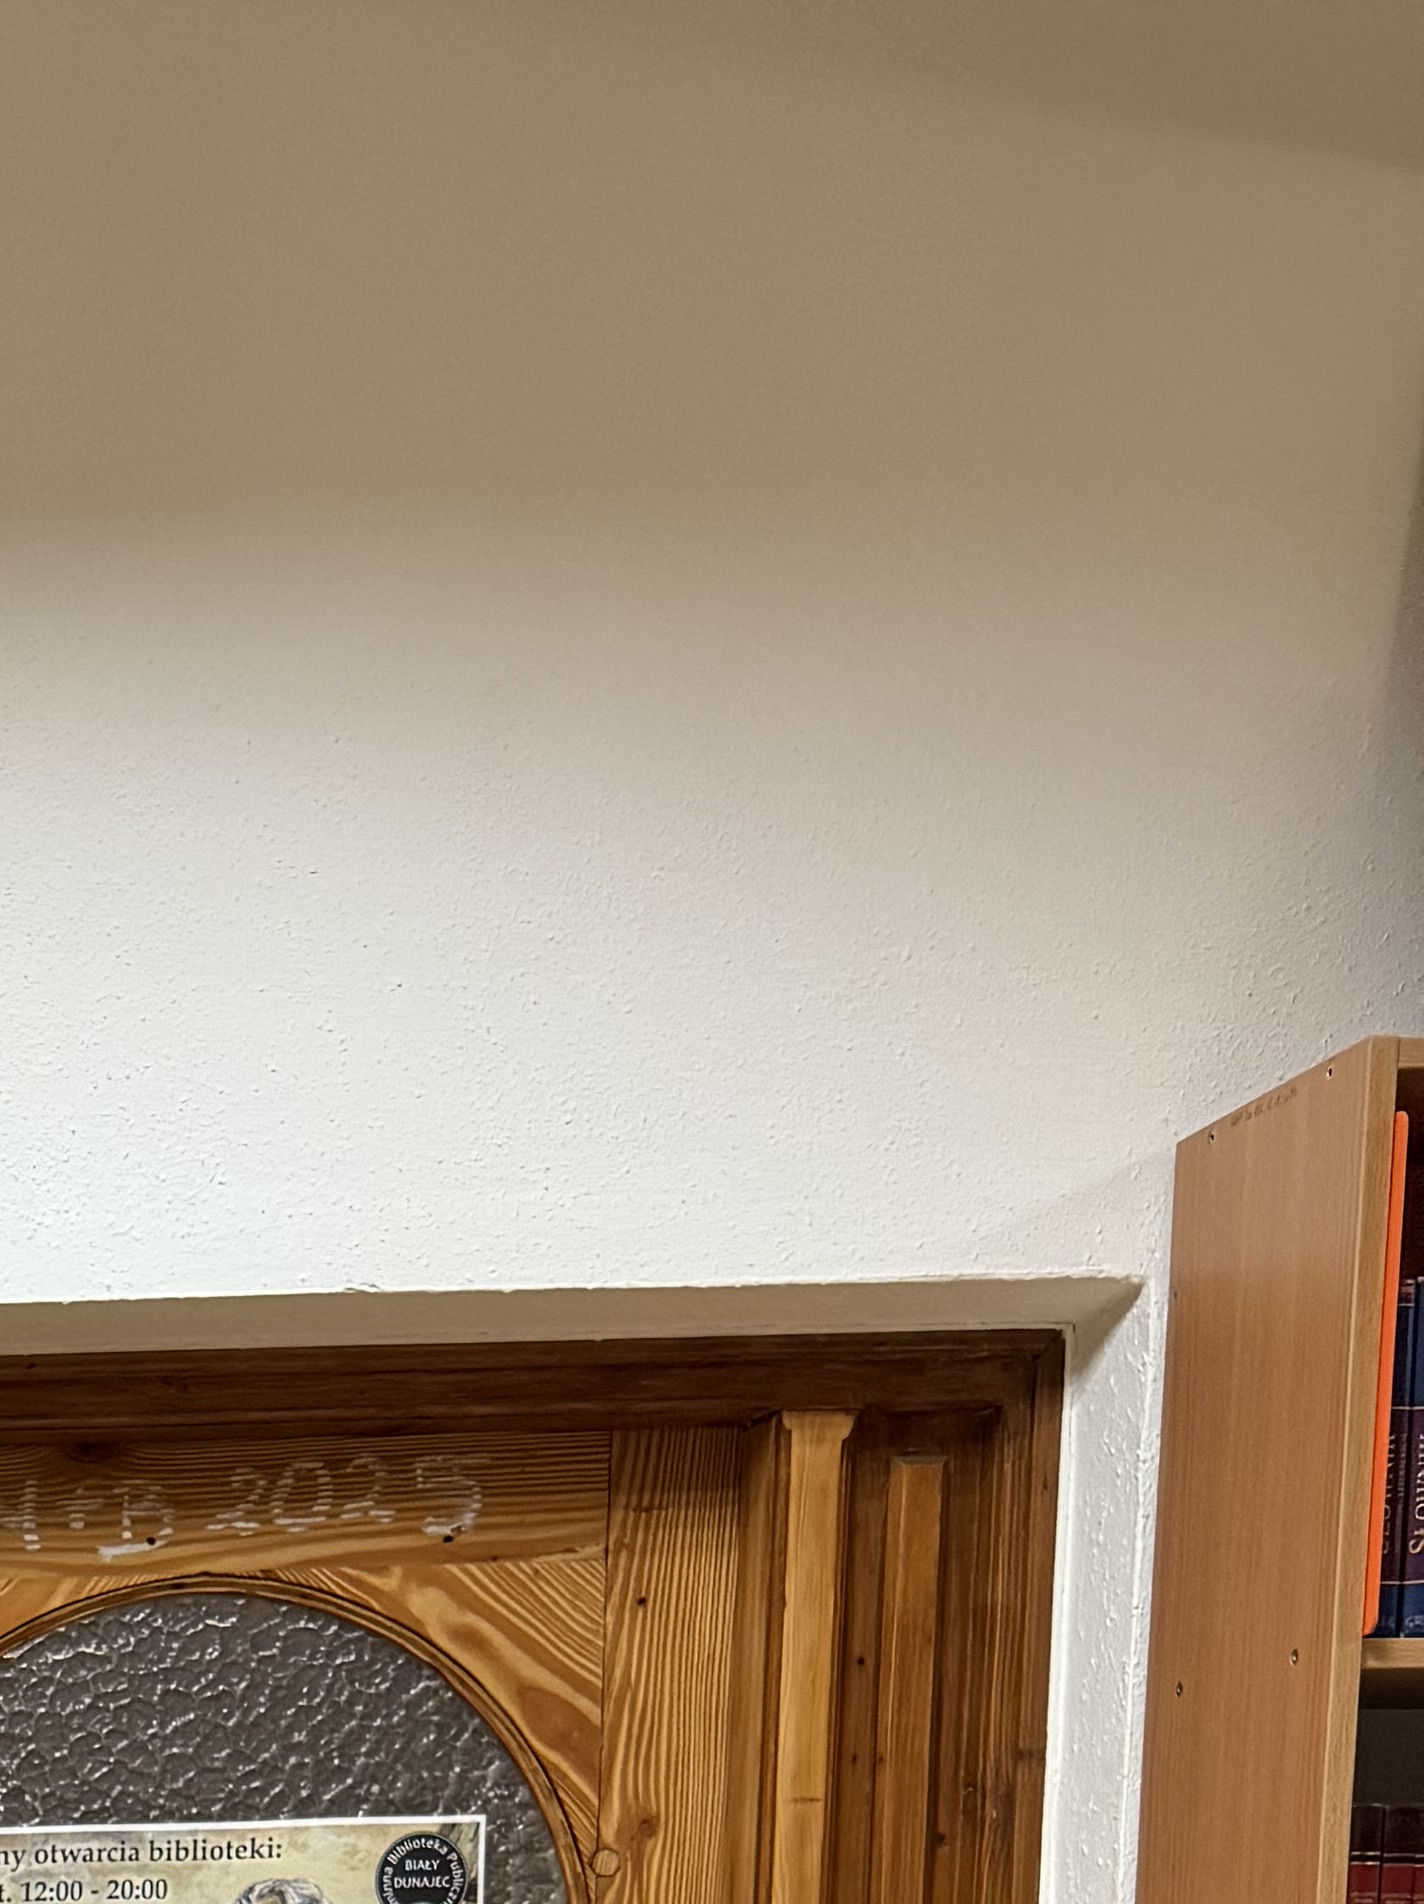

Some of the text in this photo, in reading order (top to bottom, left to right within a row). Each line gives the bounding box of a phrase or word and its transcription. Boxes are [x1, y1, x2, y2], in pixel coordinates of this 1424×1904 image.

[34, 1841, 140, 1865] otwarcia
[149, 1837, 283, 1862] biblioteki:
[405, 1860, 440, 1871] BIAŁY
[20, 1880, 83, 1902] 12:00
[106, 1878, 168, 1900] 20:00
[393, 1876, 451, 1889] DUNAJEC
